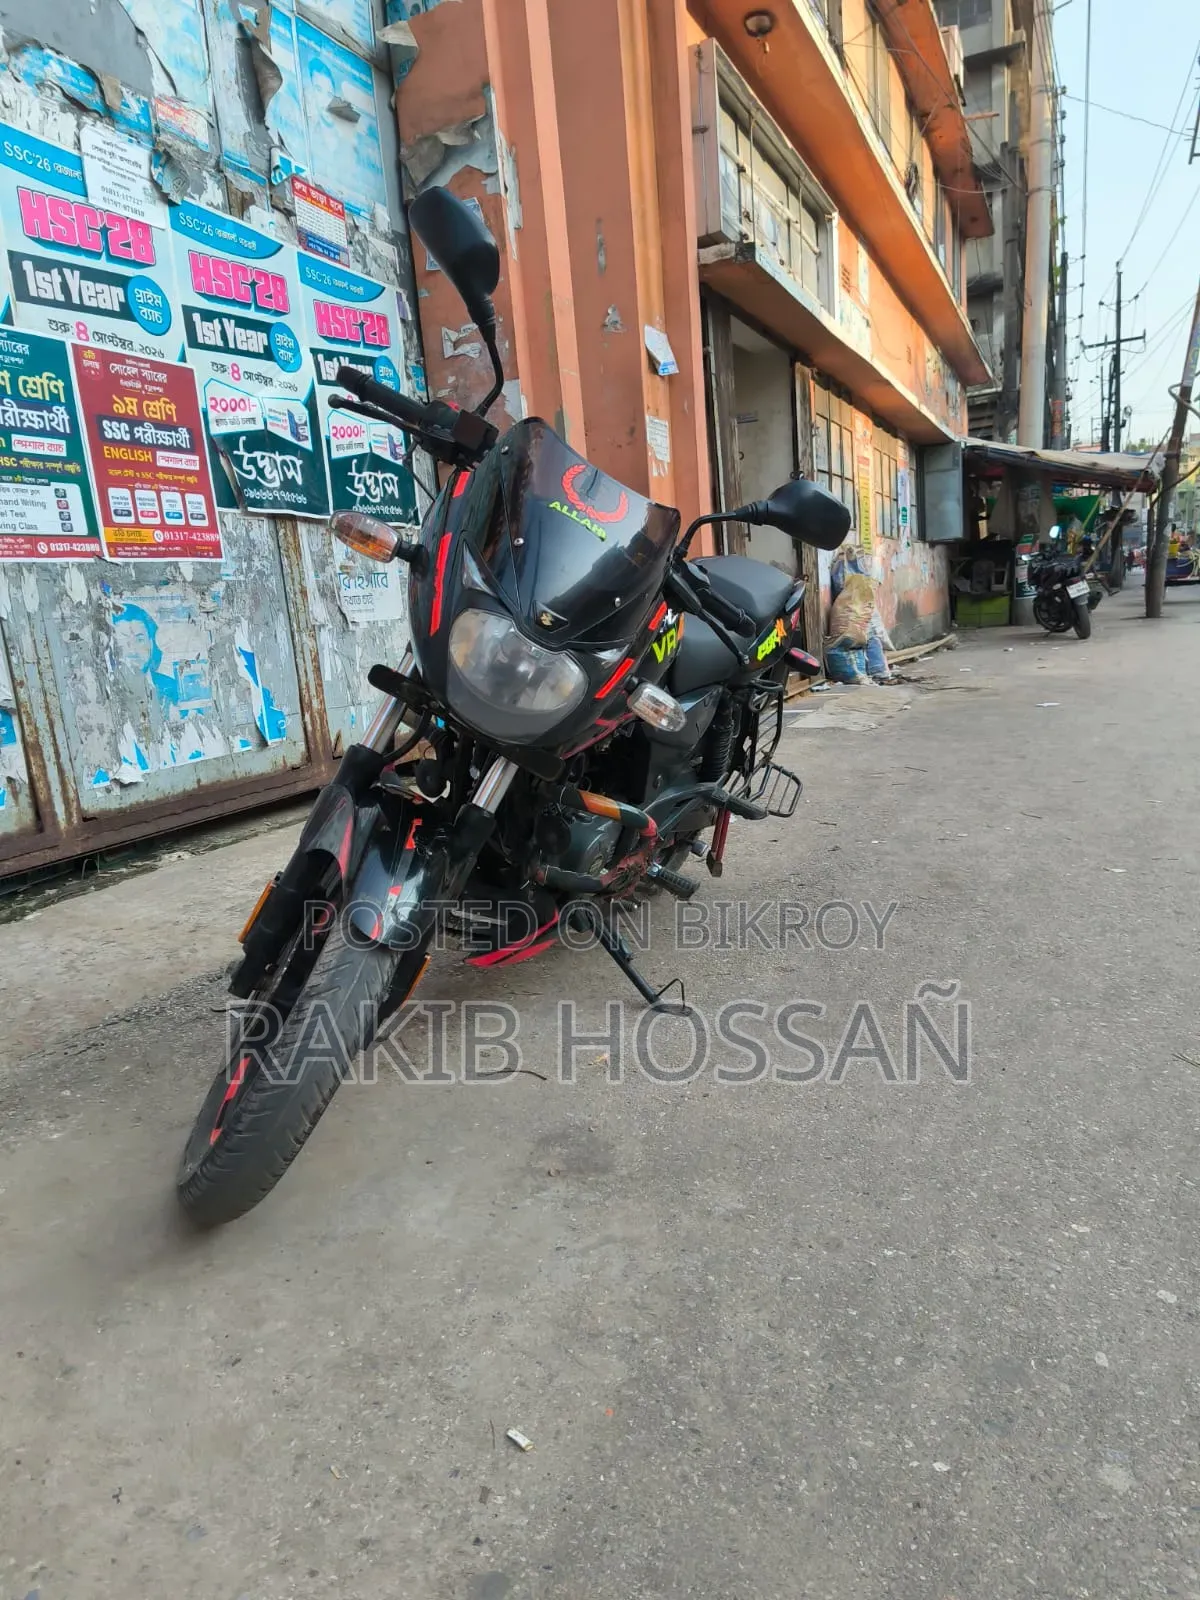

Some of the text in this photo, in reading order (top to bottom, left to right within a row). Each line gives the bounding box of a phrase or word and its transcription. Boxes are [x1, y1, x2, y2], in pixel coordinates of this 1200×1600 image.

[3, 140, 51, 172] SSC'26
[17, 186, 156, 267] HSC'28
[178, 212, 213, 236] SSC'26
[22, 260, 125, 312] 1st Year
[188, 249, 290, 315] HSC'28
[305, 266, 332, 286] SSC'26
[192, 312, 268, 354] 1st Year
[313, 299, 391, 348] HSC'28
[18, 371, 65, 403] শ্রেণি
[142, 397, 177, 423] শ্রেণি
[102, 419, 131, 441] SSC
[103, 445, 153, 462] ENGLISH
[232, 436, 303, 488] উদ্ভাস
[346, 459, 399, 503] উদ্ভাস
[20, 499, 47, 510] Writing
[18, 521, 39, 531] Class
